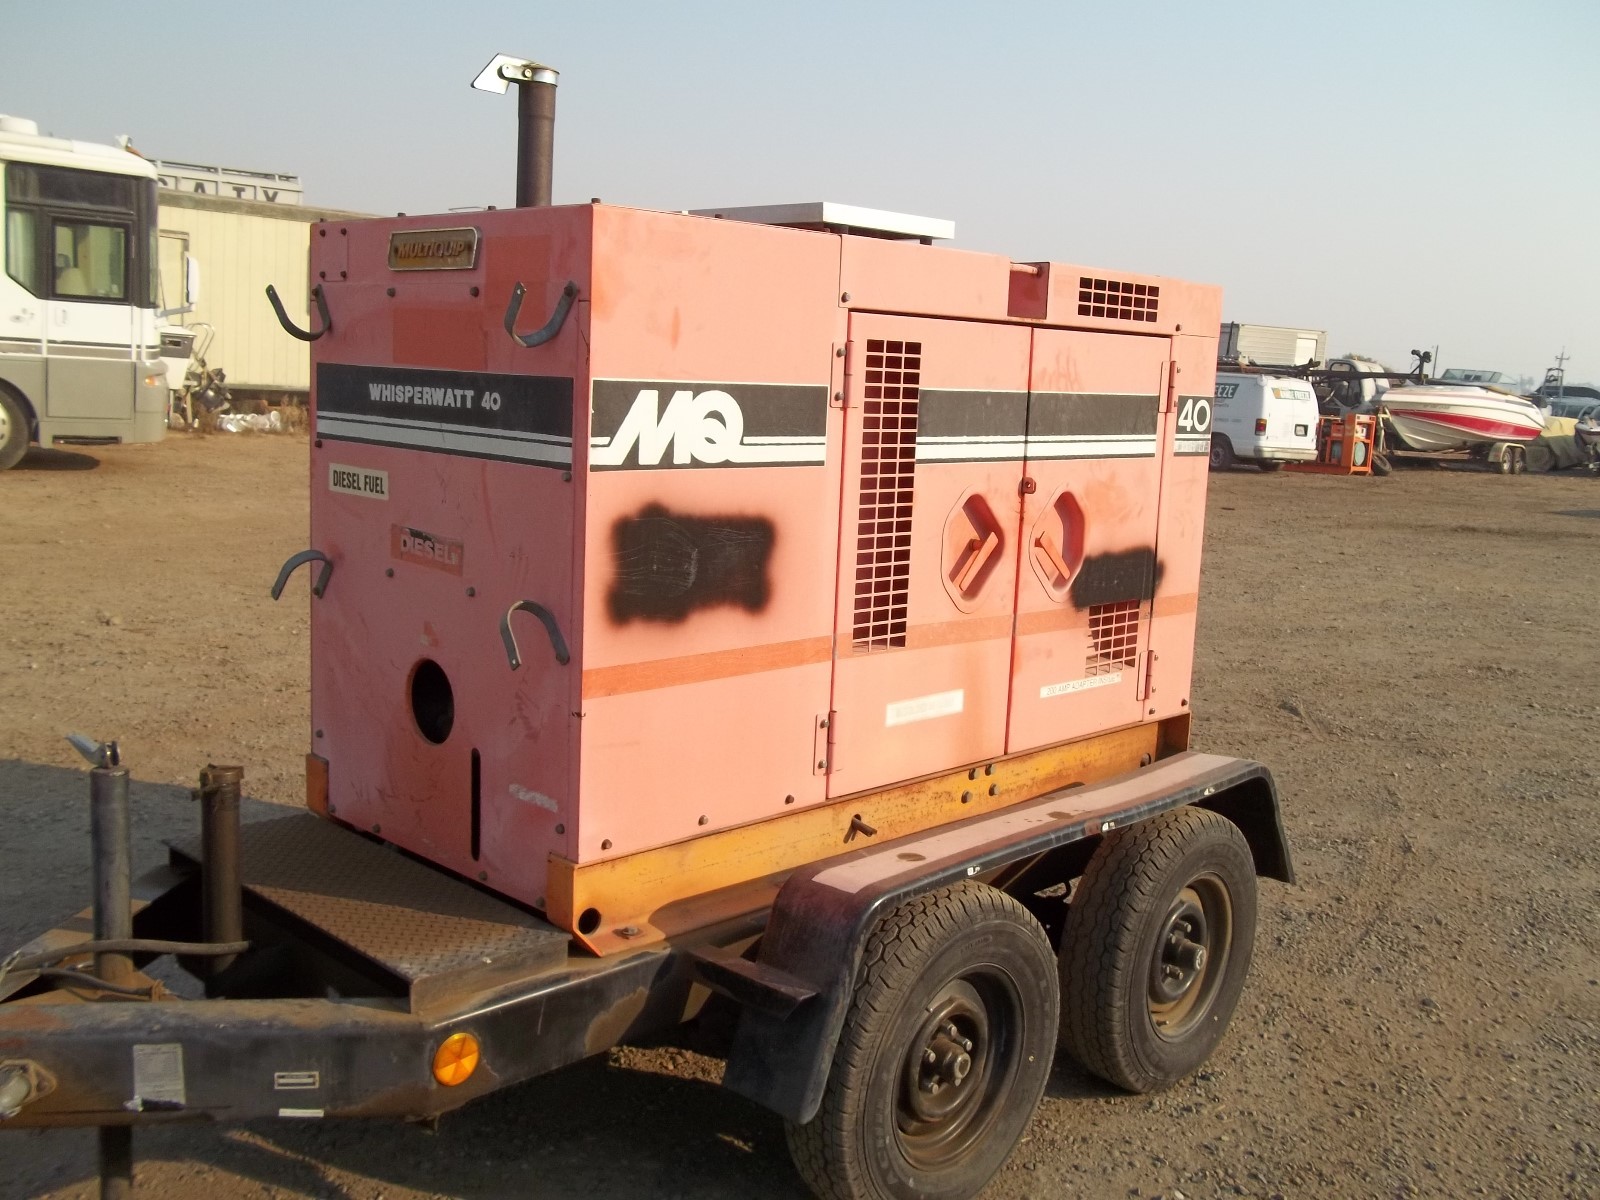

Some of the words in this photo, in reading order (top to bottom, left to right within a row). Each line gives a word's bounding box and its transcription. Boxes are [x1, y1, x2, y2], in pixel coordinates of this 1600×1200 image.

[398, 240, 465, 258] MULTIQUIP
[369, 384, 474, 409] WHISPERWATT
[481, 391, 502, 411] 40
[607, 389, 744, 466] MQ
[1178, 398, 1211, 432] 40
[332, 469, 362, 491] DIESEL
[364, 474, 385, 495] FUEL
[1058, 683, 1071, 692] AMP
